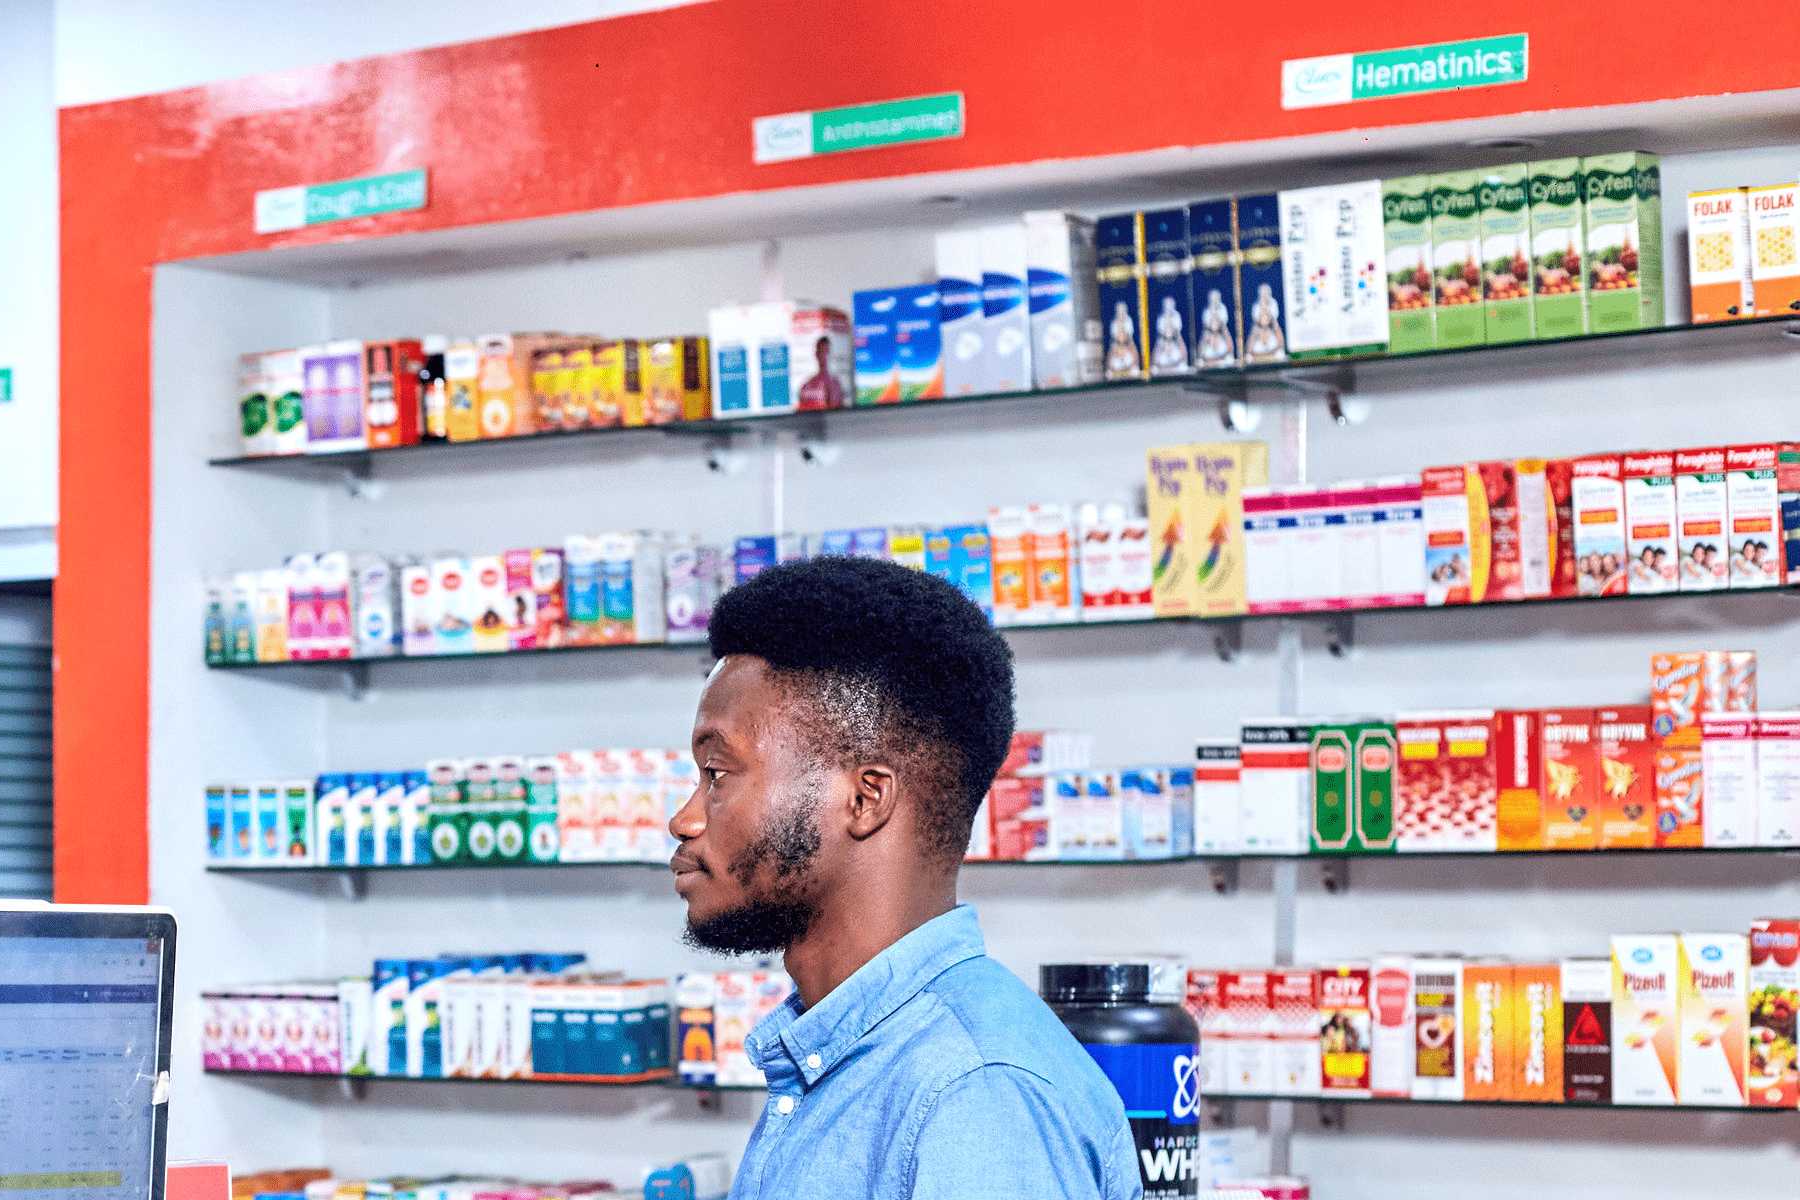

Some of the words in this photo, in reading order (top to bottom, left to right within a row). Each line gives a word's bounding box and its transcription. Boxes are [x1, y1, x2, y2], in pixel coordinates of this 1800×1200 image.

[1356, 49, 1514, 90] Hematinics
[1694, 199, 1733, 216] FOLAK
[1754, 192, 1795, 212] FOLAK
